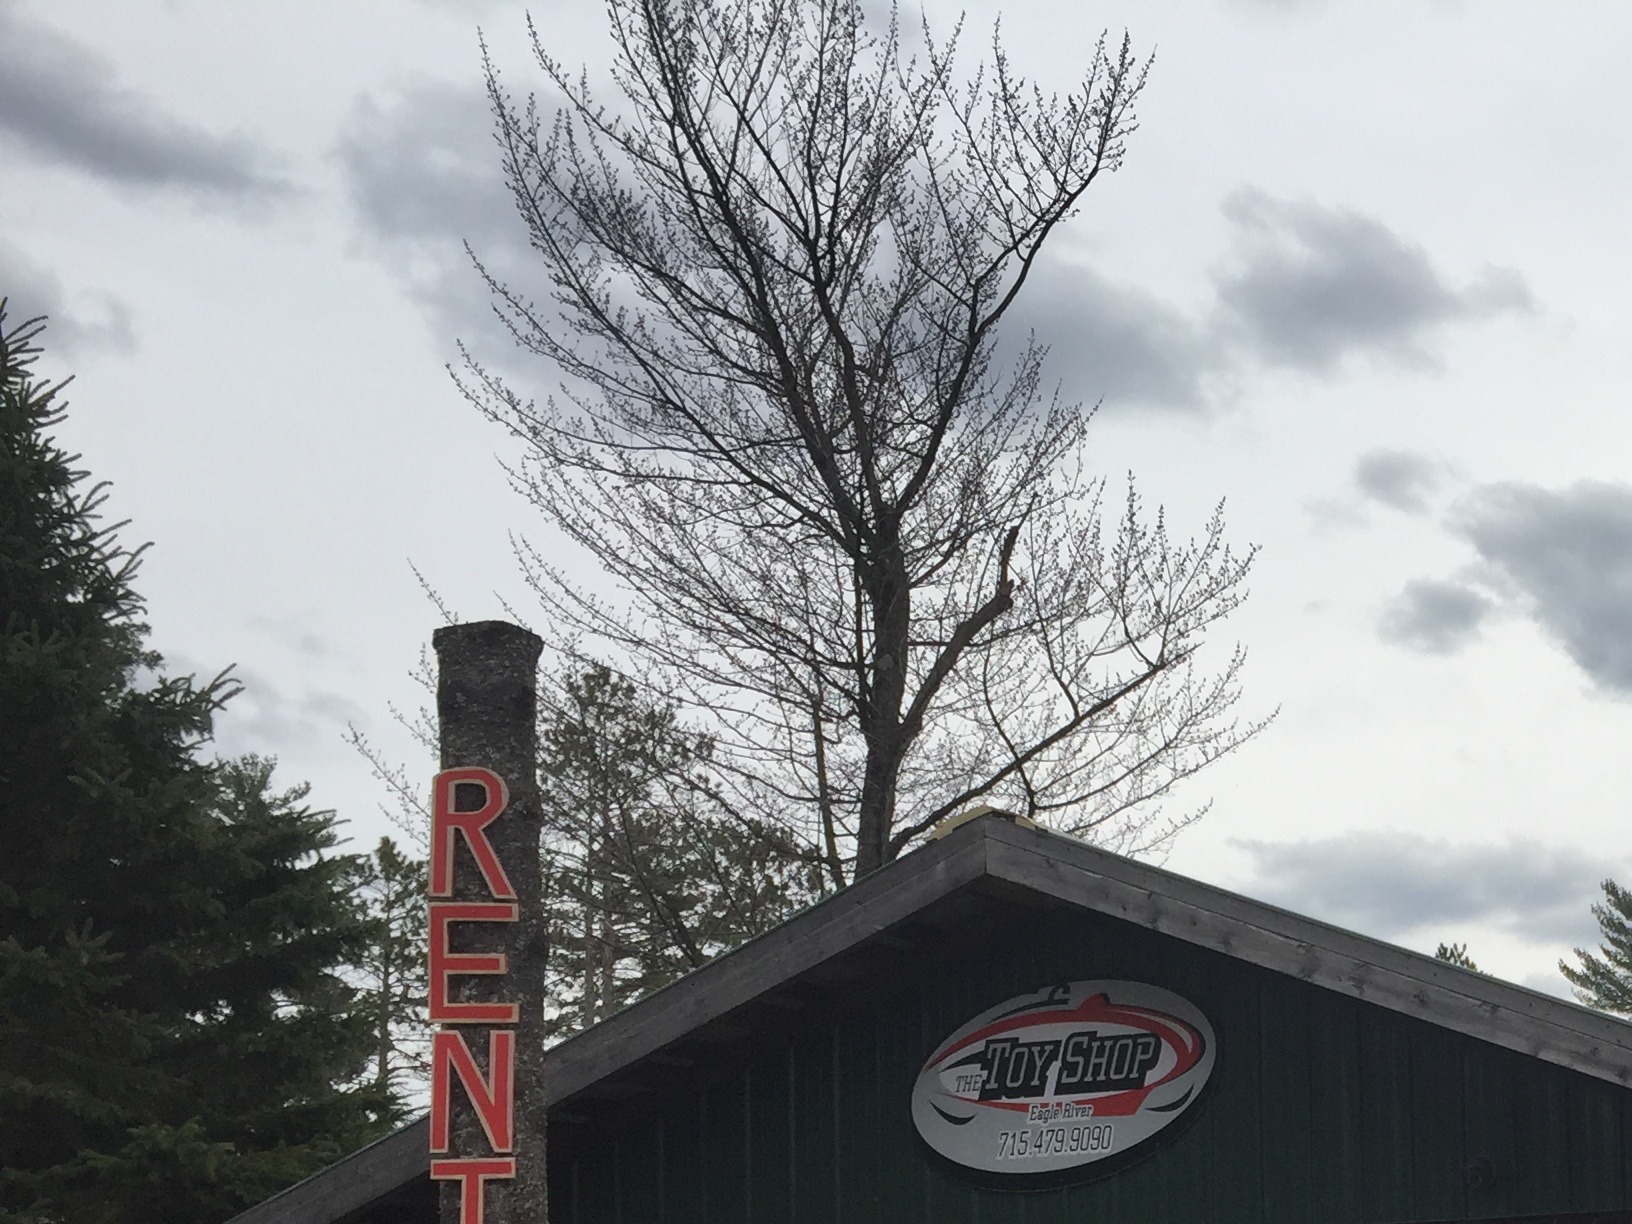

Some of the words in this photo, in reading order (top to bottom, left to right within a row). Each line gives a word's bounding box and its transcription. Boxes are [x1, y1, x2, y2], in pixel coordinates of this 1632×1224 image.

[955, 1074, 983, 1093] THE
[985, 1041, 1055, 1090] TOY
[1060, 1036, 1157, 1085] SHOP
[1029, 1104, 1060, 1123] Eagle
[1062, 1102, 1093, 1119] River
[998, 1125, 1113, 1157] 715.479.9090
